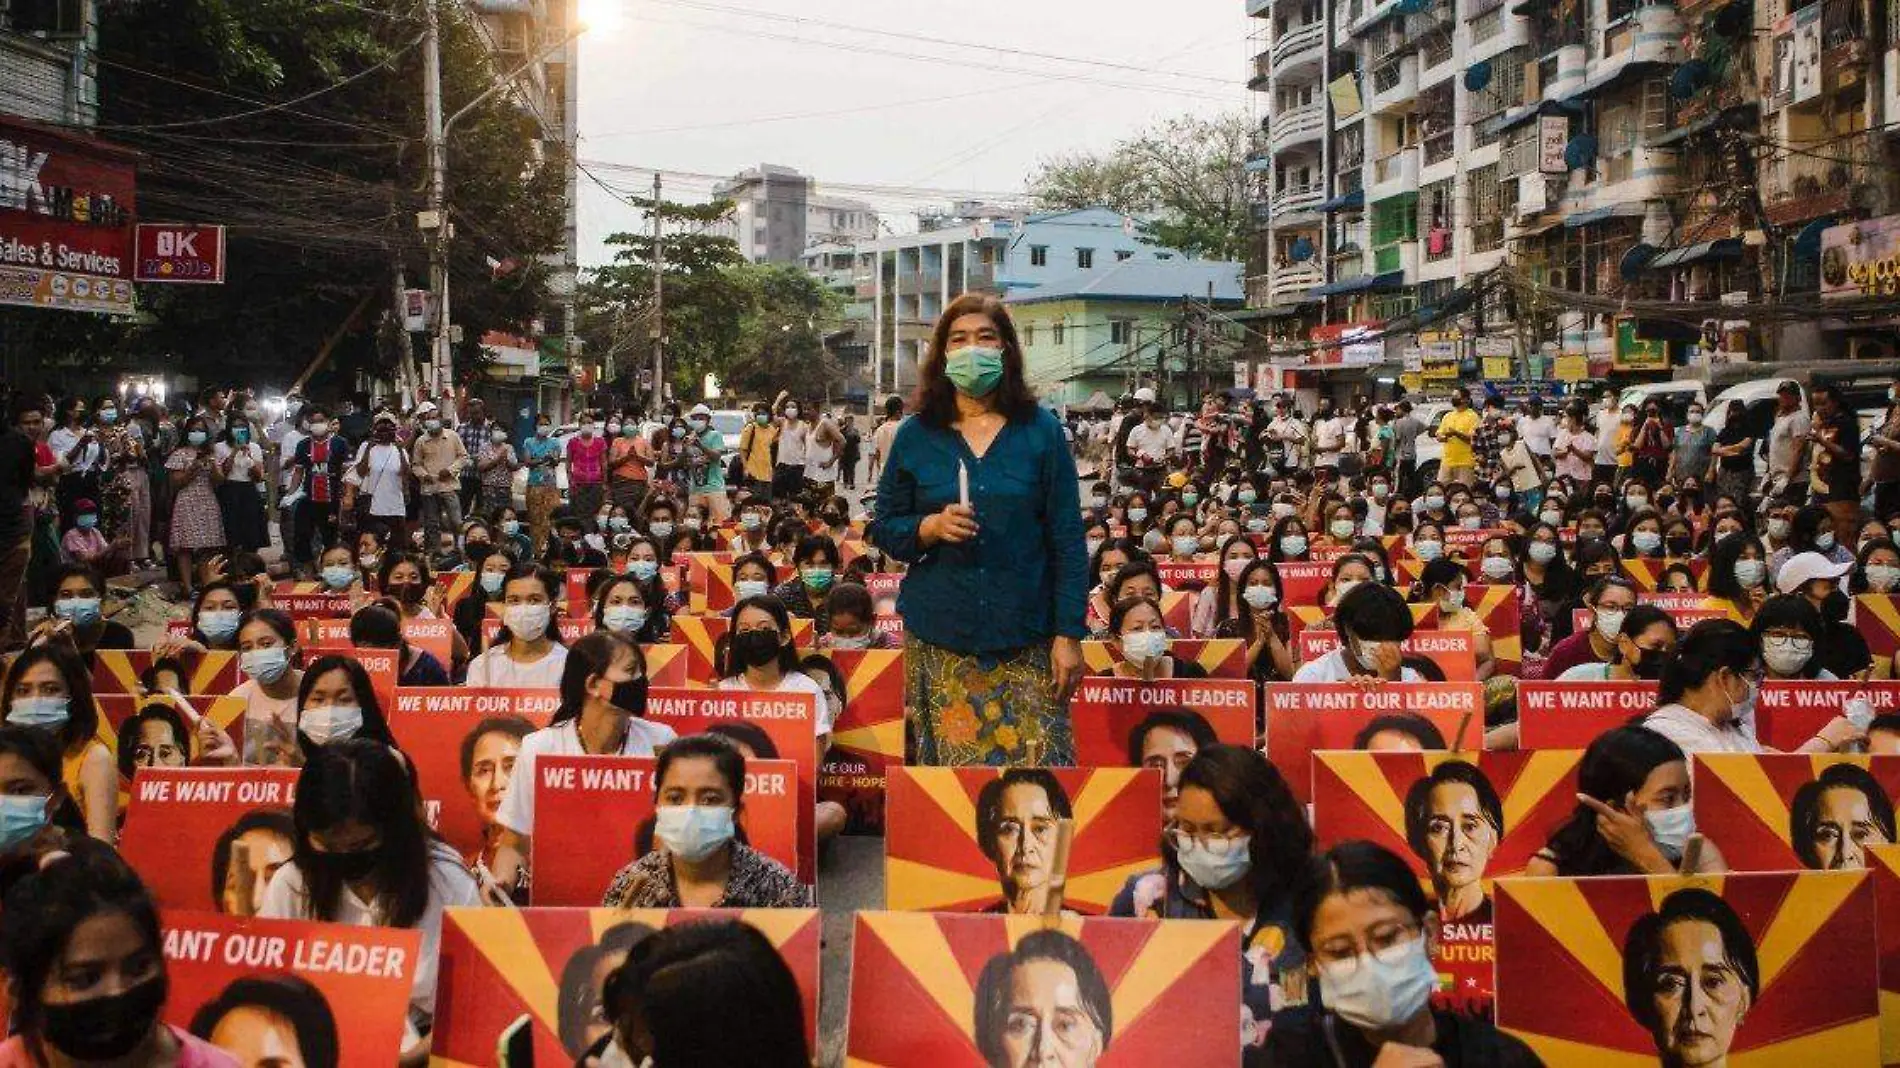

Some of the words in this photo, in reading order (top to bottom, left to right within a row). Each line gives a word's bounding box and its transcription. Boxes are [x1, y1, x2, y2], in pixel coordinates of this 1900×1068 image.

[157, 232, 198, 256] OK
[41, 241, 54, 265] &
[58, 244, 120, 275] Services
[1175, 569, 1195, 579] OUR
[1291, 567, 1319, 577] WANT
[294, 600, 325, 611] WANT
[407, 625, 447, 638] EADER
[1308, 639, 1330, 651] WE
[1414, 638, 1467, 652] LEADER
[398, 696, 422, 712] WE
[426, 696, 474, 712] WANT
[475, 697, 509, 712] OUR
[1084, 687, 1135, 703] WANT
[1140, 688, 1177, 705] OUR
[1182, 689, 1248, 707] LEADER
[1272, 692, 1300, 709] WE
[1304, 692, 1358, 709] WANT
[1364, 692, 1401, 709] OUR
[1406, 692, 1473, 710] LEADER
[1527, 691, 1556, 708] WE
[1560, 691, 1615, 708] WANT
[1761, 690, 1790, 707] WE
[1795, 690, 1850, 708] WANT
[701, 700, 738, 718] OUR
[743, 701, 808, 720] LEADER
[840, 763, 866, 774] OUR
[543, 767, 576, 789] WE
[581, 769, 644, 791] WANT
[853, 776, 886, 789] HOPE
[140, 781, 170, 802] WE
[176, 782, 234, 802] WANT
[237, 782, 280, 803] OUR
[1443, 923, 1493, 940] SAVE
[161, 929, 220, 962] ANT
[223, 933, 285, 968] OUR
[291, 940, 406, 978] LEADER
[1442, 945, 1494, 961] UTUR
